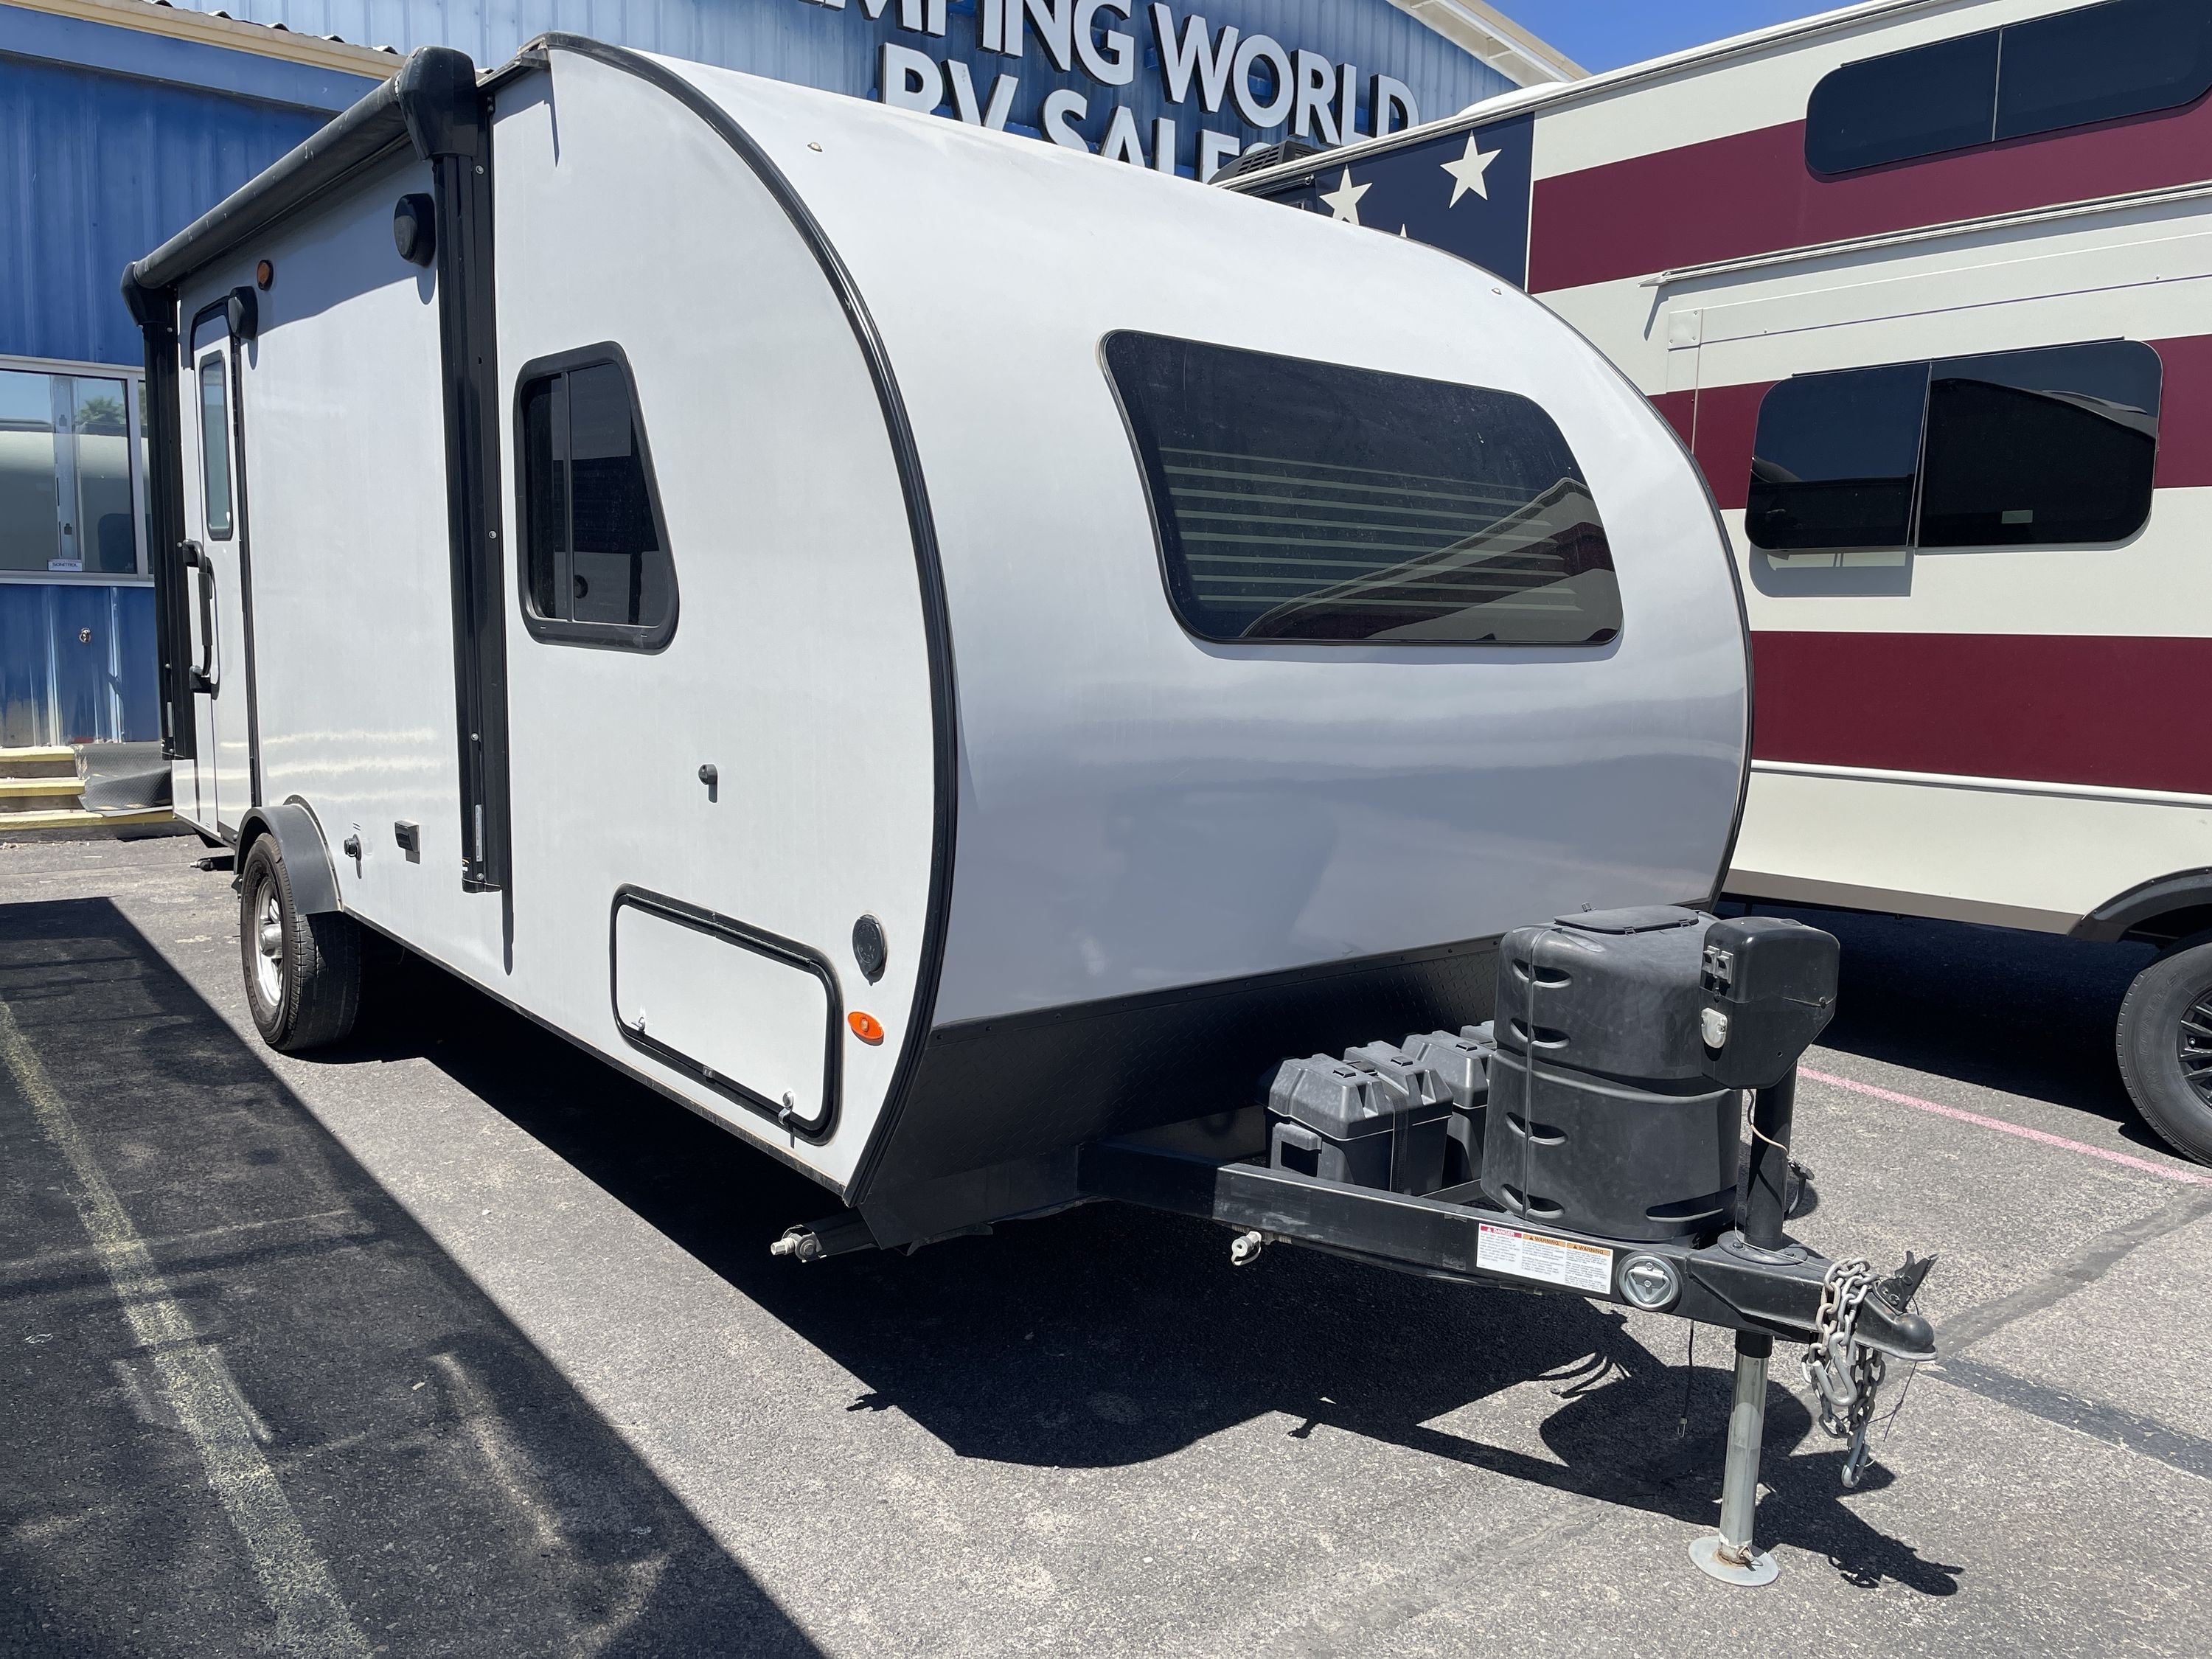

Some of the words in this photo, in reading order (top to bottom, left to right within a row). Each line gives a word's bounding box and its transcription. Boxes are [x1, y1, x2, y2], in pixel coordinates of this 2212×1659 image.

[1153, 2, 1420, 147] WORLD
[1043, 89, 1272, 183] SALE
[1492, 1227, 1515, 1237] DANGER
[1534, 1236, 1559, 1246] WARNING
[1579, 1245, 1604, 1255] WARNING
